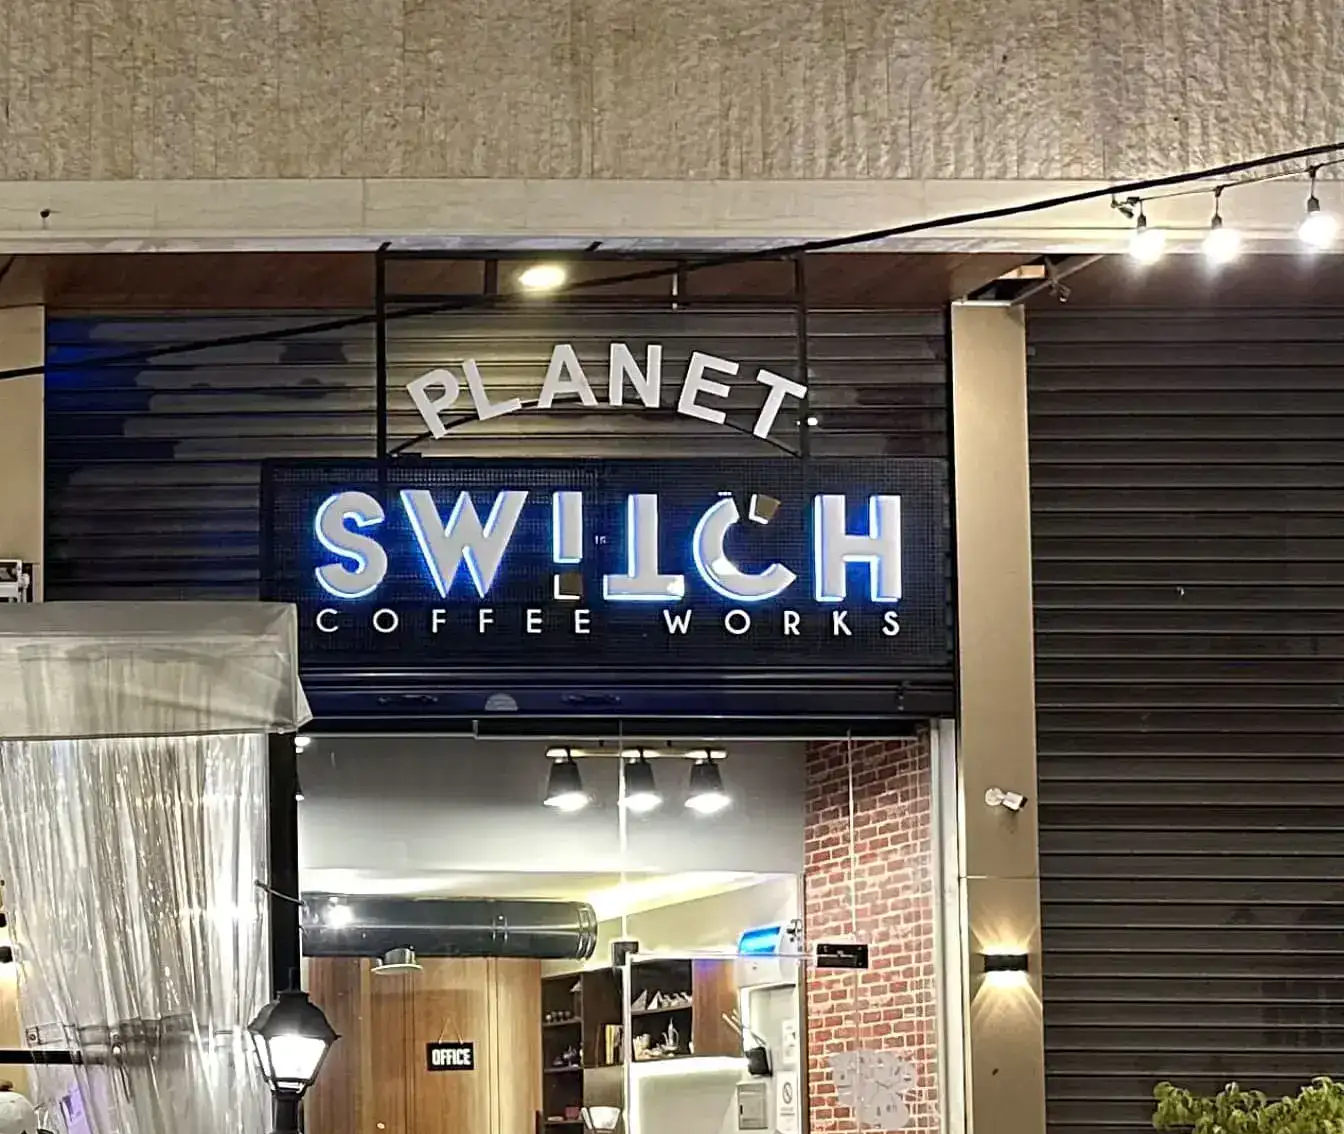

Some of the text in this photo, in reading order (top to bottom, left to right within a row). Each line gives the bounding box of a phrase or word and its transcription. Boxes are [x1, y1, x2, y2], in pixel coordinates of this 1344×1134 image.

[406, 342, 806, 440] PLANET
[314, 489, 903, 602] SWITCH
[317, 608, 901, 636] COFFEE WORKS
[432, 1048, 471, 1066] OFFICE
